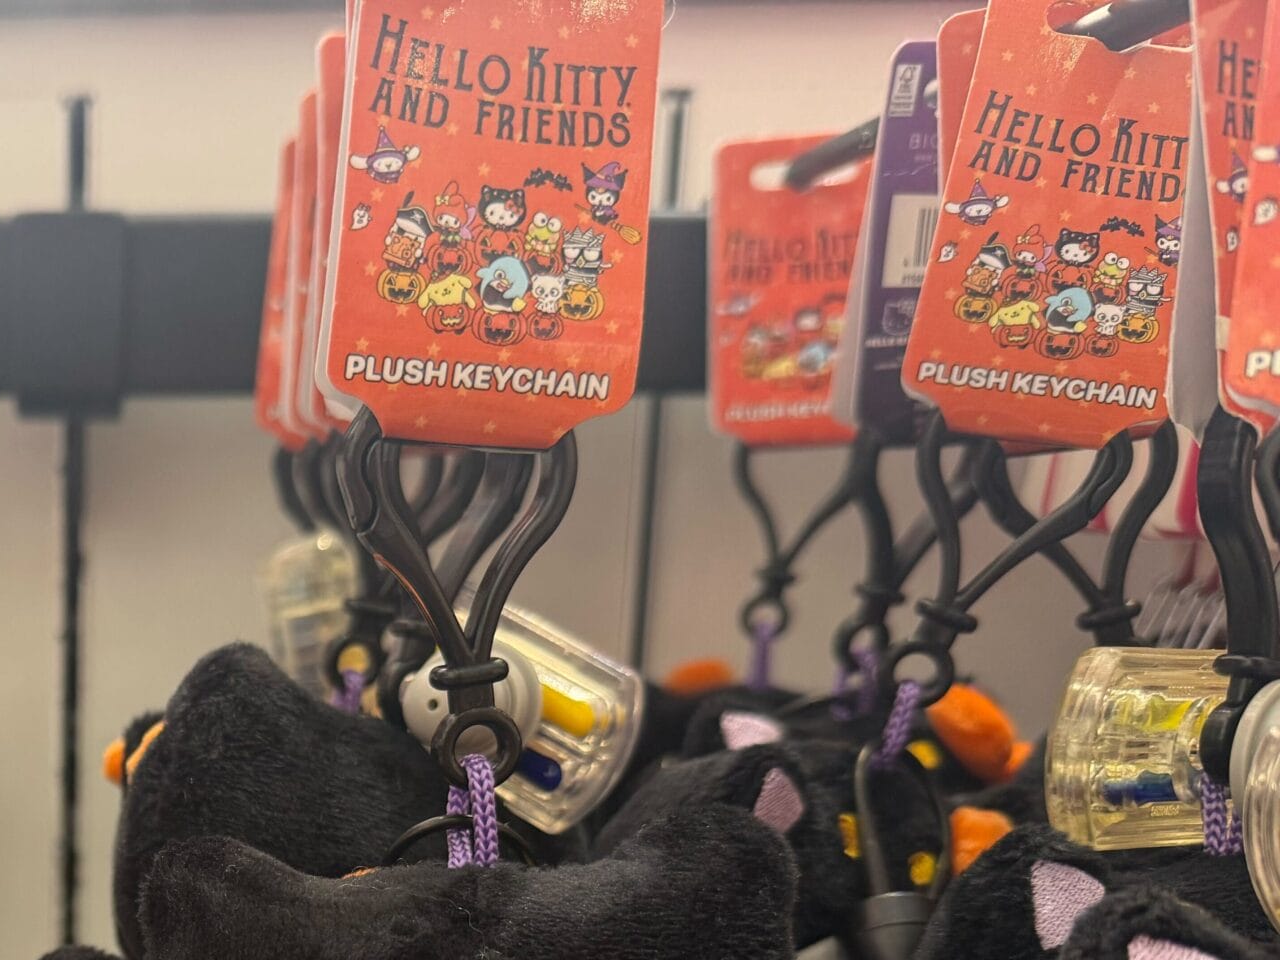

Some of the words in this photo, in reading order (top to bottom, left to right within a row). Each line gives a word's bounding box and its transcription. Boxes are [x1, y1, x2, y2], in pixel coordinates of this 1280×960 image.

[369, 14, 511, 96] HELLO
[525, 46, 637, 107] KITTY
[368, 76, 449, 129] AND
[474, 98, 631, 148] FRIENDS
[974, 90, 1101, 157] HELLO
[1110, 117, 1189, 170] KITT
[968, 140, 1042, 182] AND
[1061, 158, 1187, 203] FRIEND
[344, 353, 448, 387] PLUSH
[452, 360, 610, 400] KEYCHAIN
[918, 361, 1008, 392] PLUSH
[1011, 372, 1158, 410] KEYCHAIN
